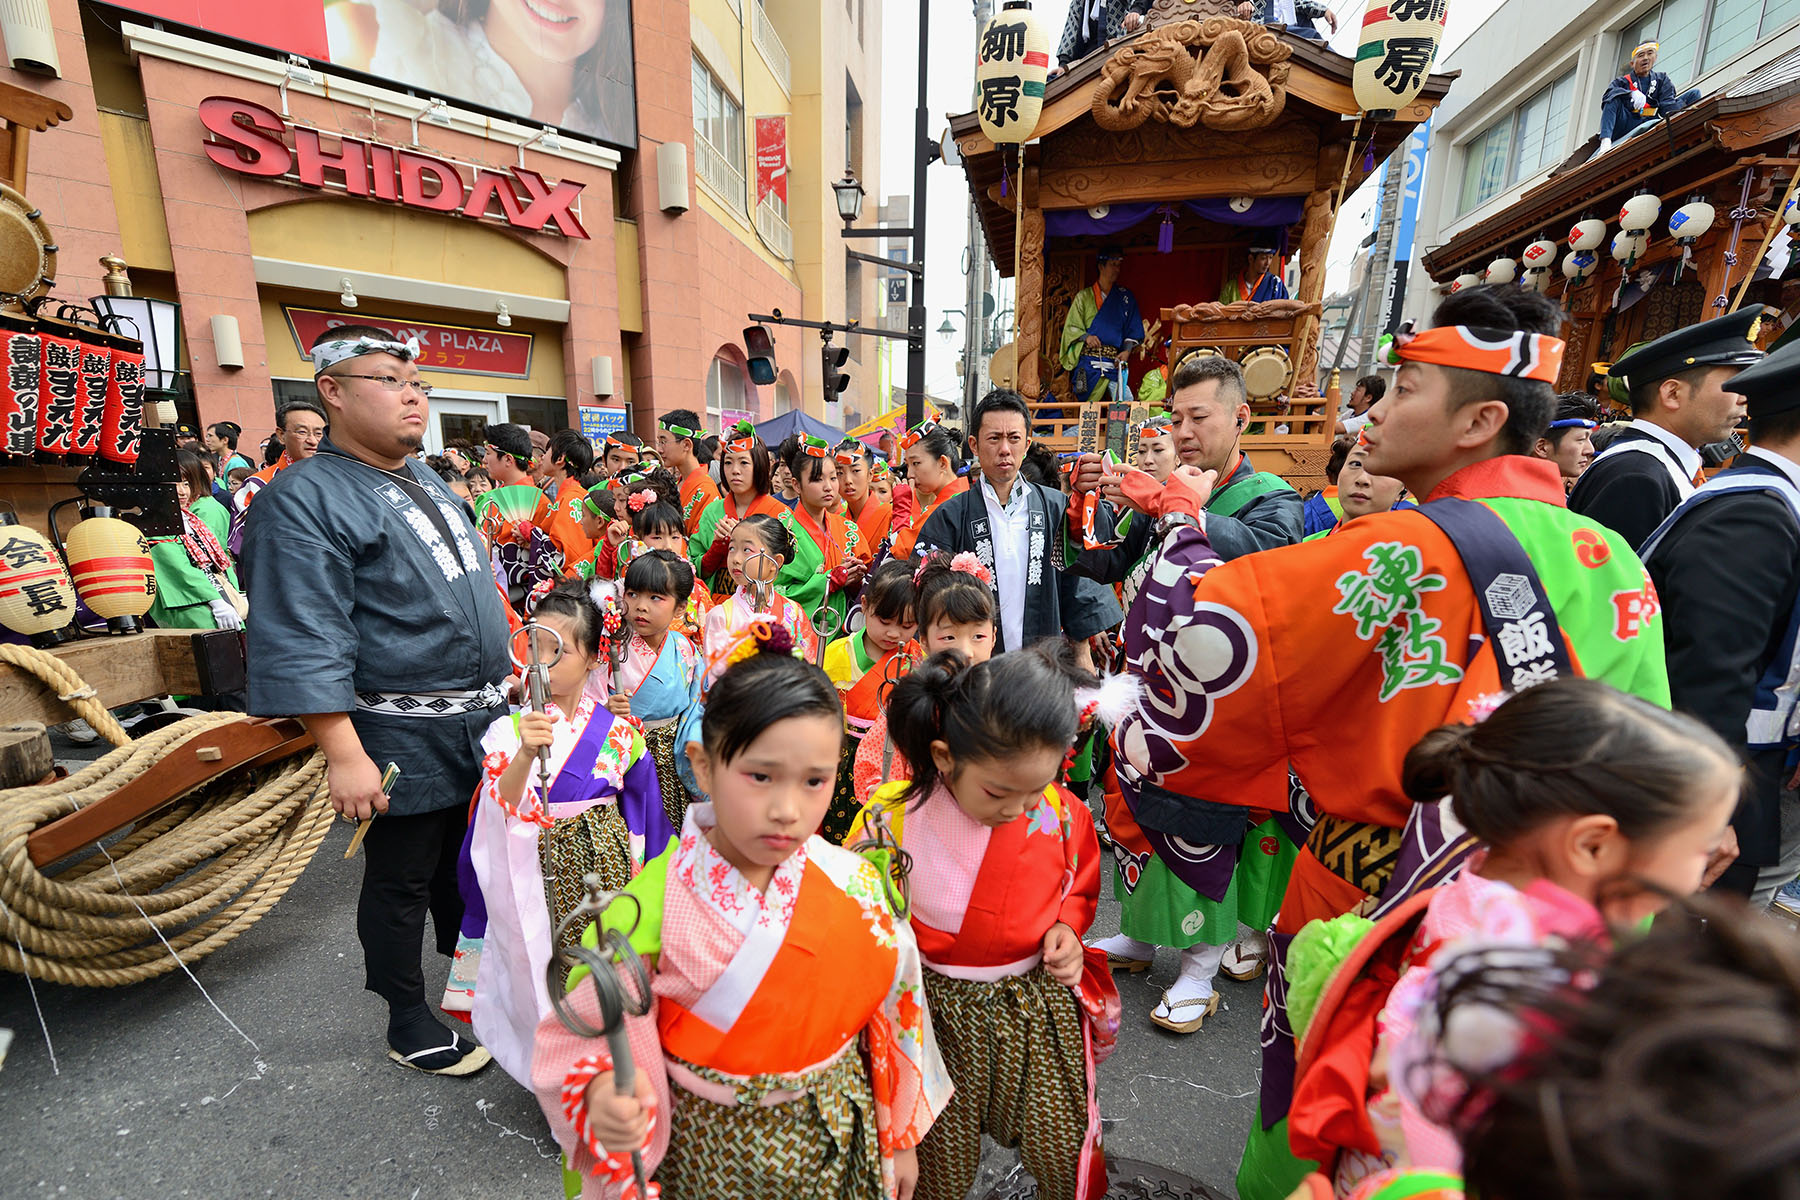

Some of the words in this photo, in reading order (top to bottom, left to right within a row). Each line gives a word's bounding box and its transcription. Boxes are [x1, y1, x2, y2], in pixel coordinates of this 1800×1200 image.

[981, 19, 1027, 128] 柳原
[199, 95, 591, 240] SHIDAX
[440, 331, 504, 353] PLAZA
